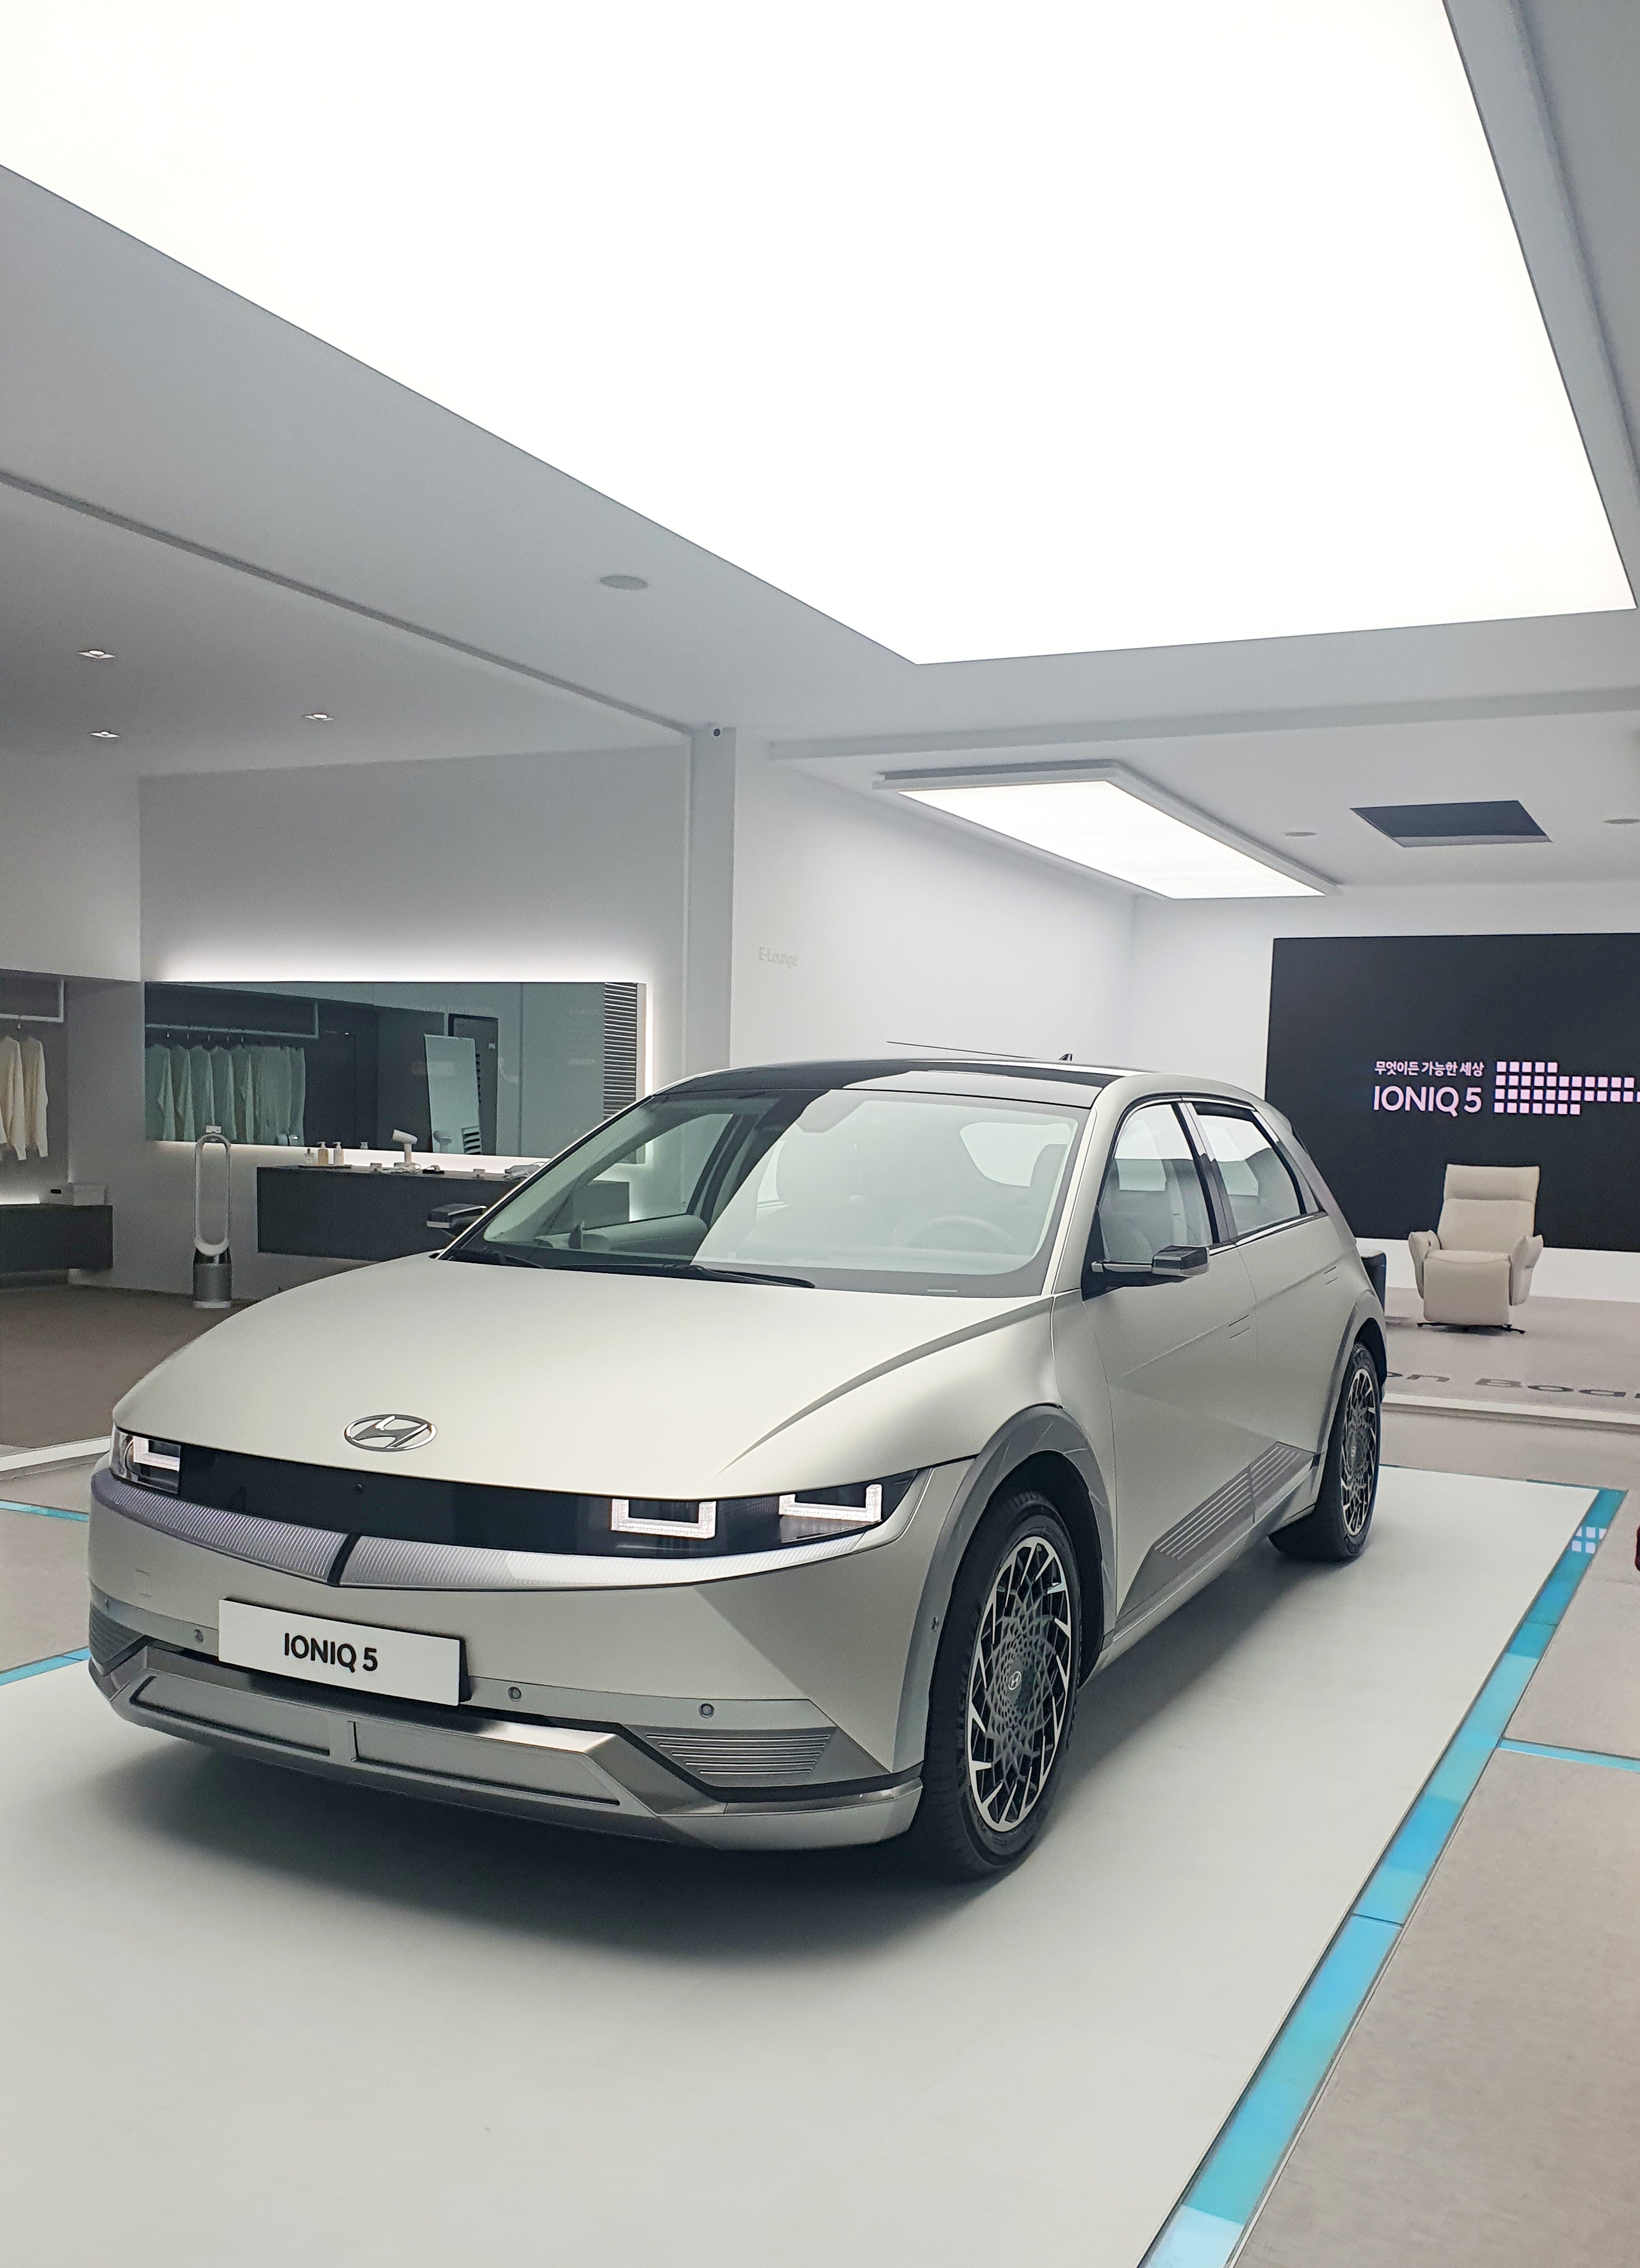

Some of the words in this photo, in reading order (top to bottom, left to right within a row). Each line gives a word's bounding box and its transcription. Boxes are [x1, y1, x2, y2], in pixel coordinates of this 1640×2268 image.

[1375, 1060, 1419, 1076] 무엇이든
[1421, 1061, 1458, 1077] 가능한
[1459, 1061, 1485, 1077] 세상
[1374, 1086, 1459, 1117] IONIQ
[1464, 1087, 1482, 1113] 5
[284, 1632, 357, 1673] IONIQ
[362, 1647, 378, 1671] 5
